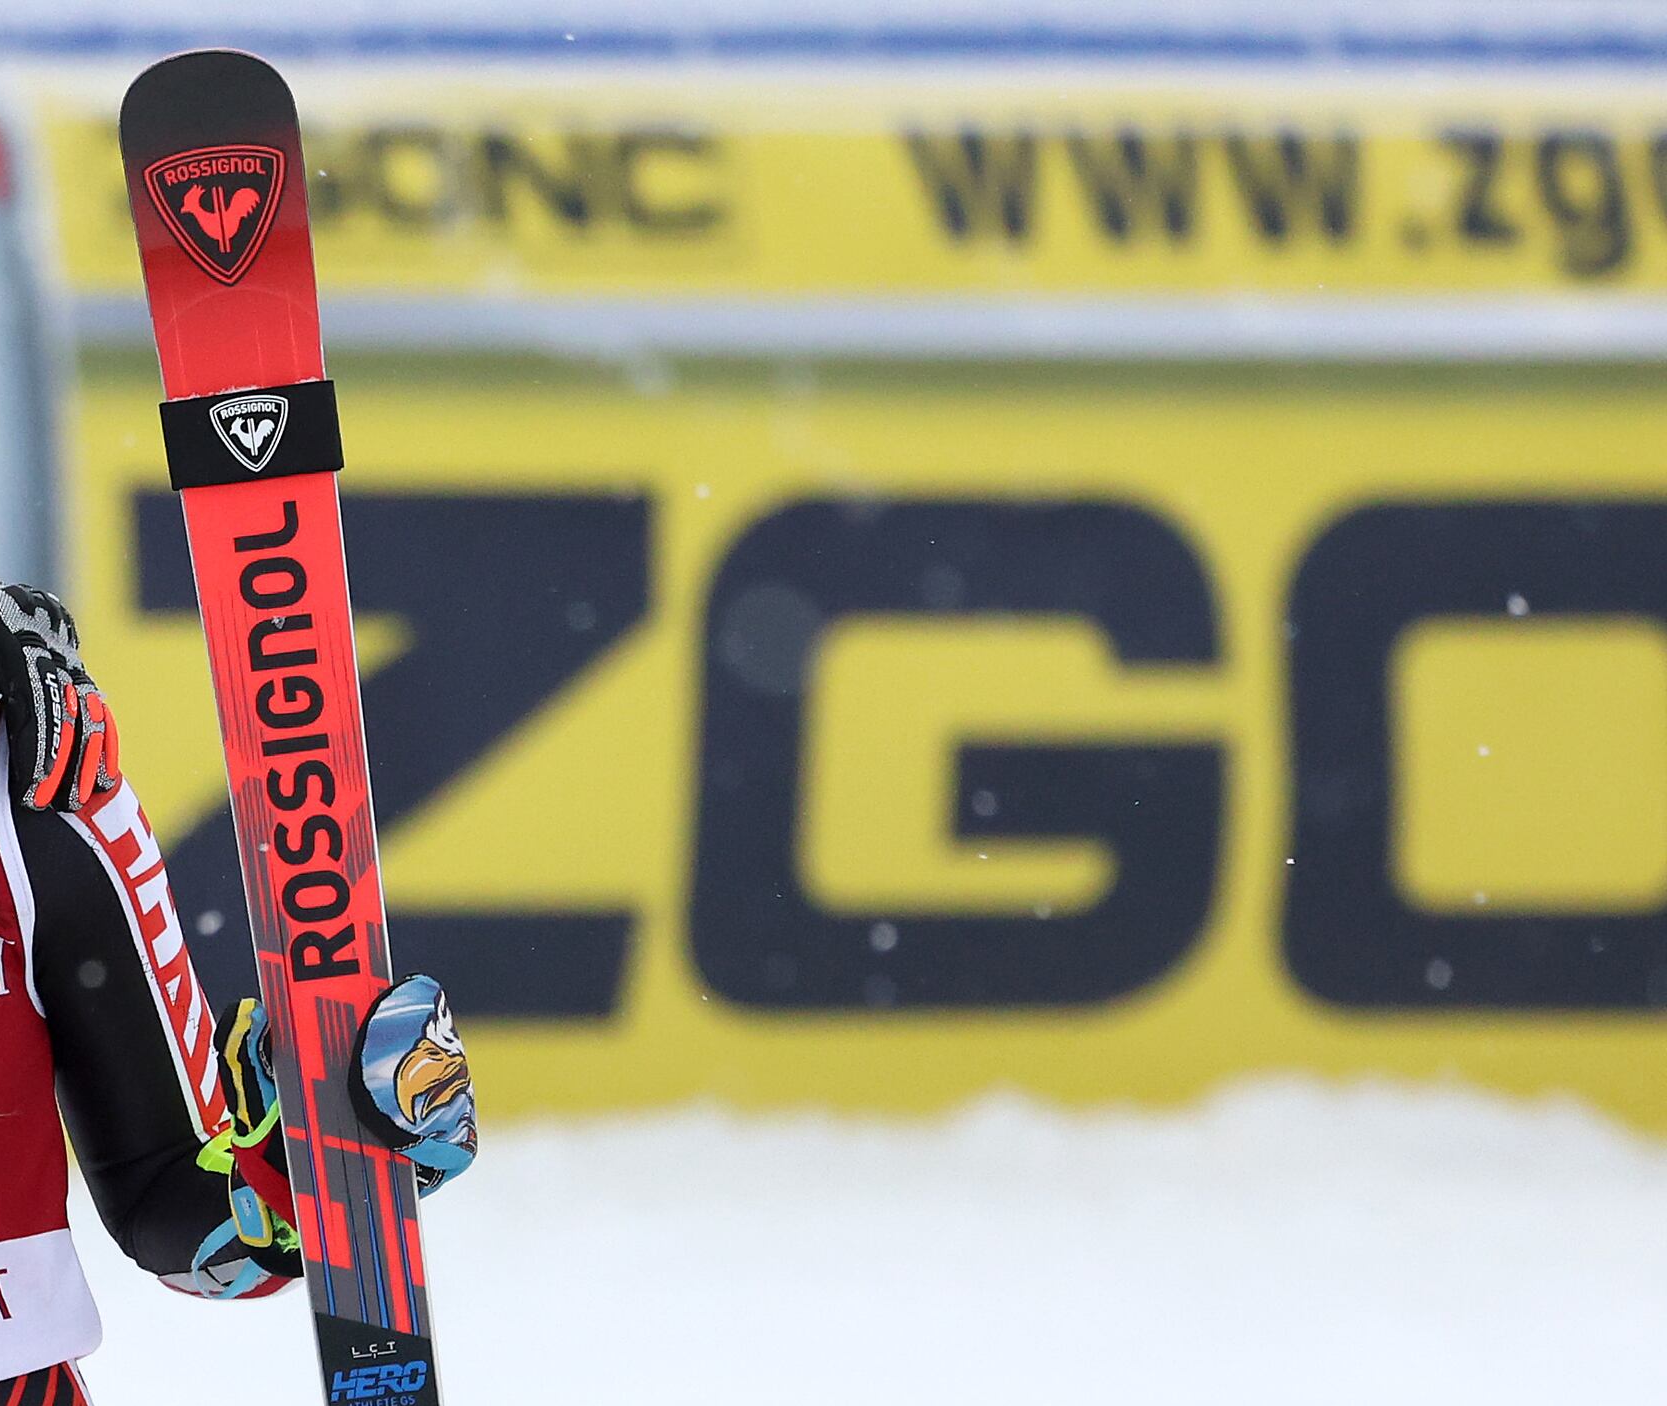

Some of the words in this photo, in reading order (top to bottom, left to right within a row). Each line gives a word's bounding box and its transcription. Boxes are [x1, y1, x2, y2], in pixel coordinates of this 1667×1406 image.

[164, 157, 267, 187] ROSSIGNOL
[220, 402, 279, 420] ROSSIGNOL
[234, 500, 361, 983] ROSSIGNOL
[331, 1360, 428, 1402] HERO
[400, 1394, 416, 1406] GS
